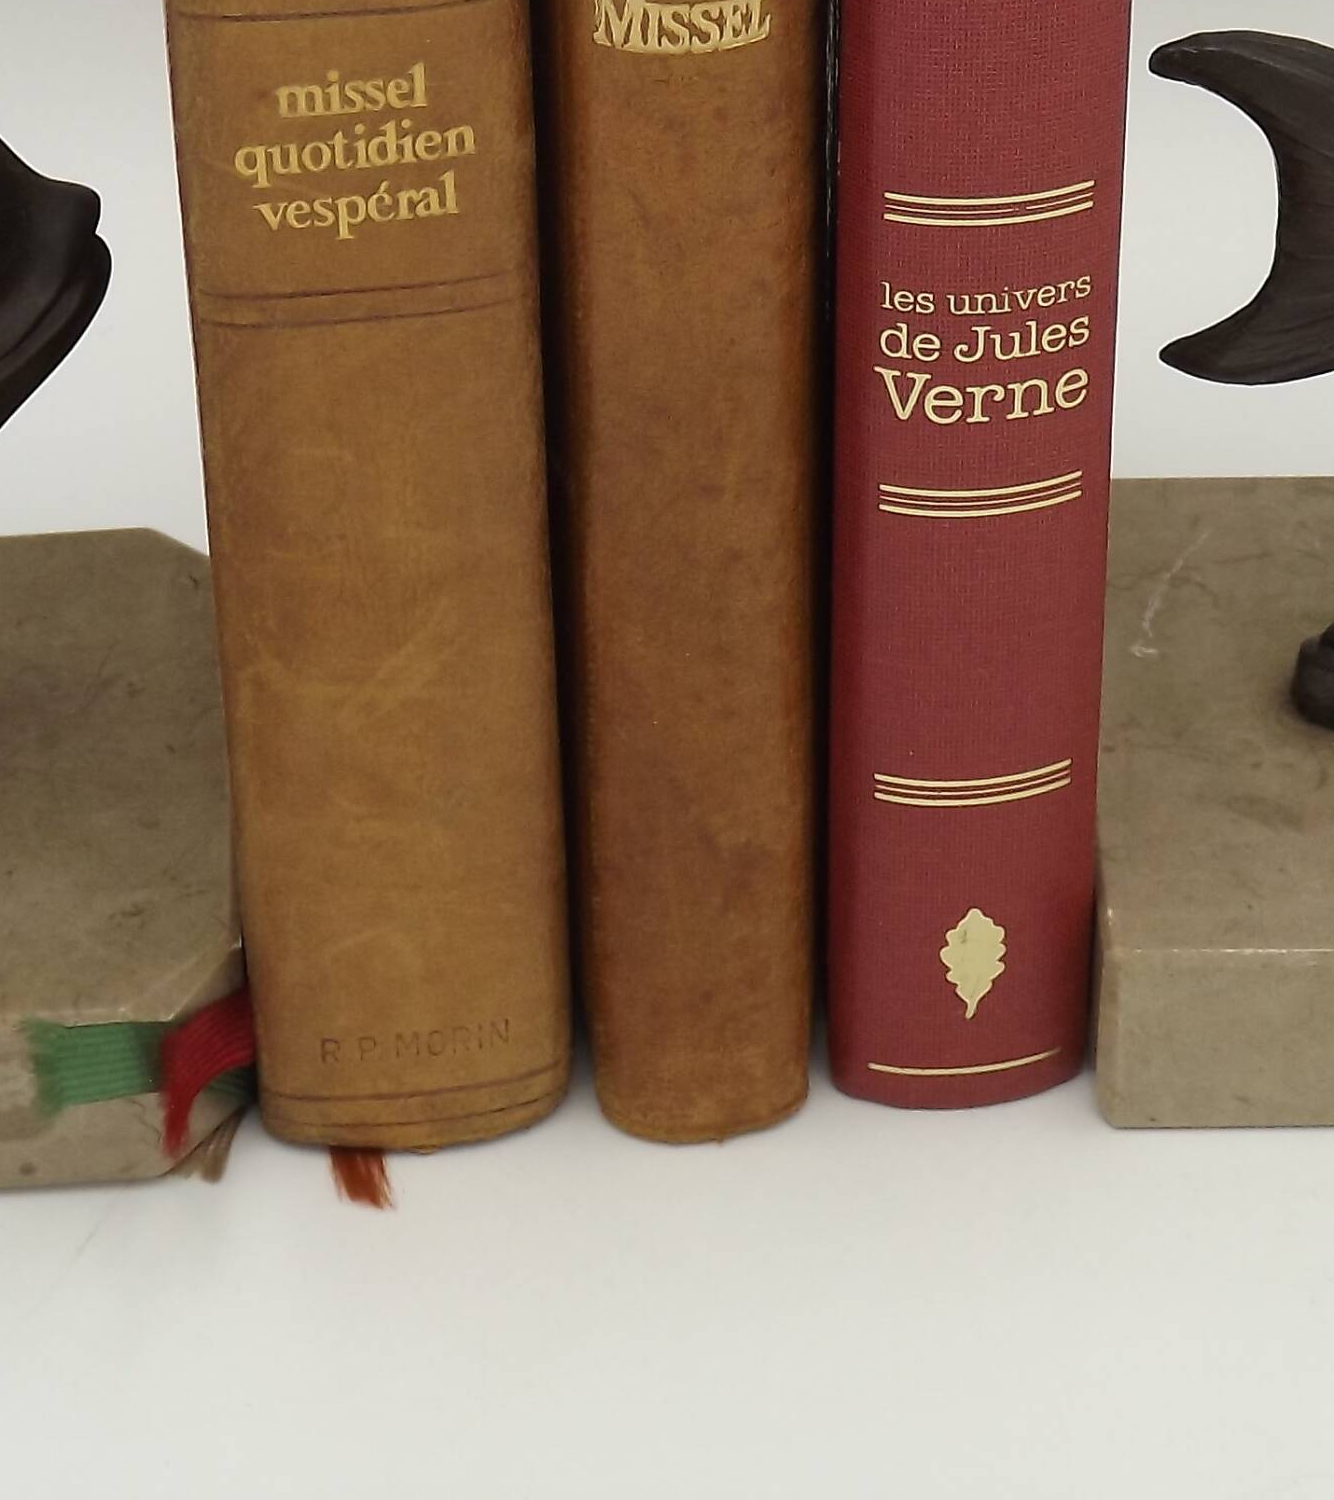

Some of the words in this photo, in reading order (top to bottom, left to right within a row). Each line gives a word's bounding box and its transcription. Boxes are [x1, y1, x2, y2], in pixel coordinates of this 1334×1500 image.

[275, 62, 428, 118] missel
[234, 118, 476, 189] quotidien
[253, 169, 459, 240] vespéral
[880, 281, 935, 313] les
[947, 275, 1092, 315] univers
[880, 323, 941, 362] de
[953, 315, 1090, 363] Jules
[873, 365, 1090, 425] Verne
[395, 1018, 510, 1059] MORIN
